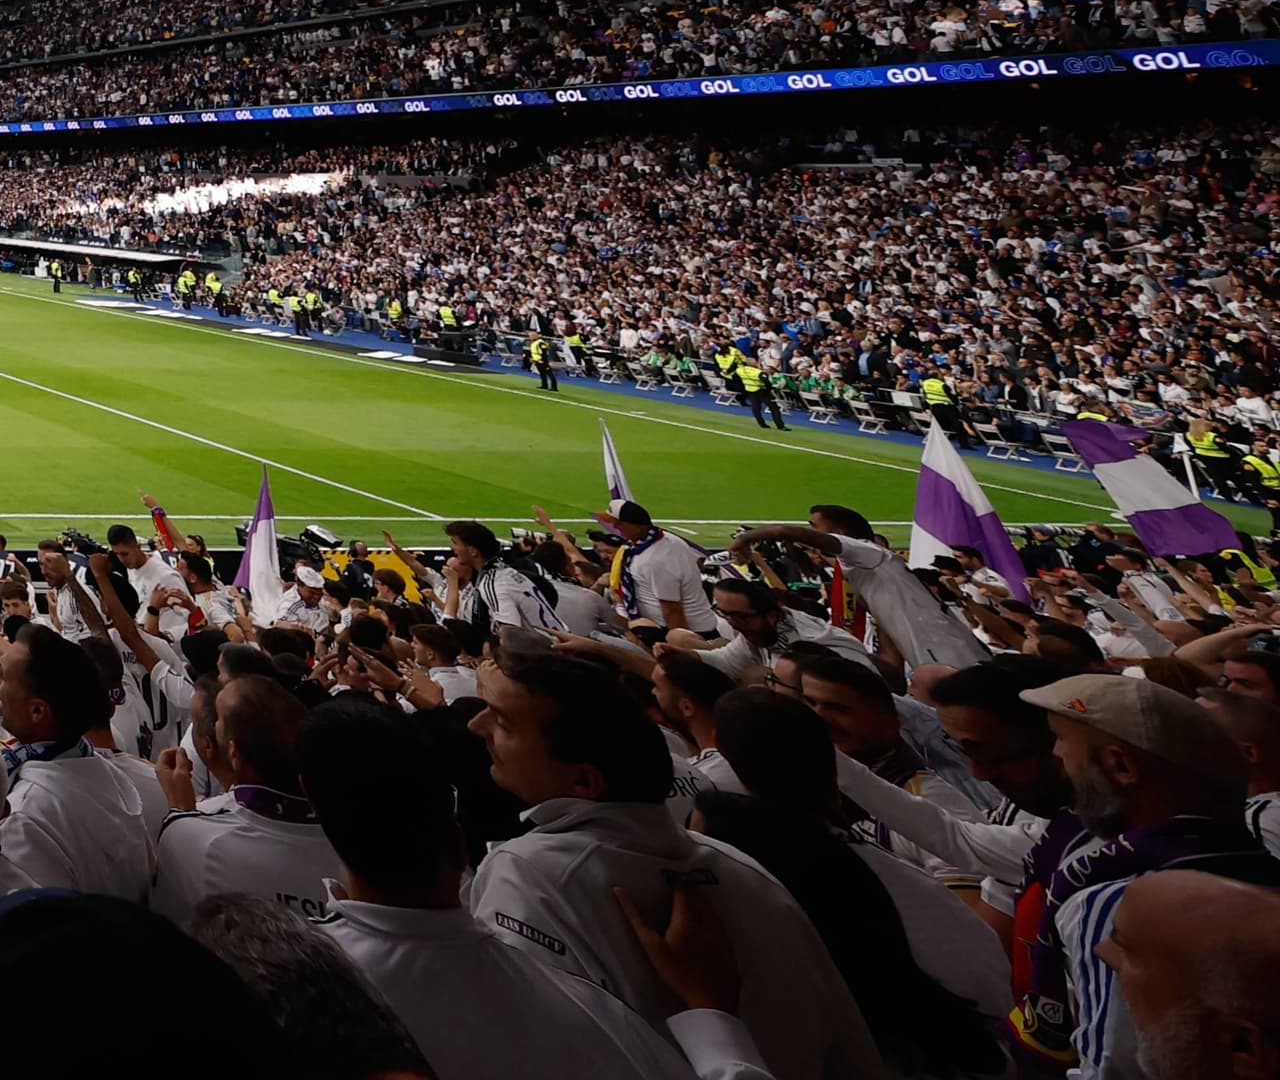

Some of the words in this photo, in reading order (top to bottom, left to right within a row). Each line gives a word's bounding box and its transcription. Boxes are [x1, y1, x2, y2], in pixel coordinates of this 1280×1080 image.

[169, 114, 185, 124] GOL
[202, 112, 218, 122] GOL
[236, 110, 253, 120] GOL
[273, 108, 292, 118] GOL
[313, 106, 334, 116] GOL
[357, 103, 379, 114] GOL
[405, 102, 430, 112] GOL
[494, 94, 522, 106] GOL
[556, 90, 587, 103] GOL
[624, 85, 659, 99] GOL
[701, 80, 740, 95] GOL
[788, 74, 832, 90] GOL
[835, 70, 884, 87] GOL
[887, 67, 937, 84] GOL
[940, 64, 994, 81] GOL
[1000, 60, 1058, 77] GOL
[1063, 56, 1127, 74] GOL
[1134, 52, 1201, 71] GOL
[1206, 50, 1268, 69] GO
[496, 914, 521, 934] FANS
